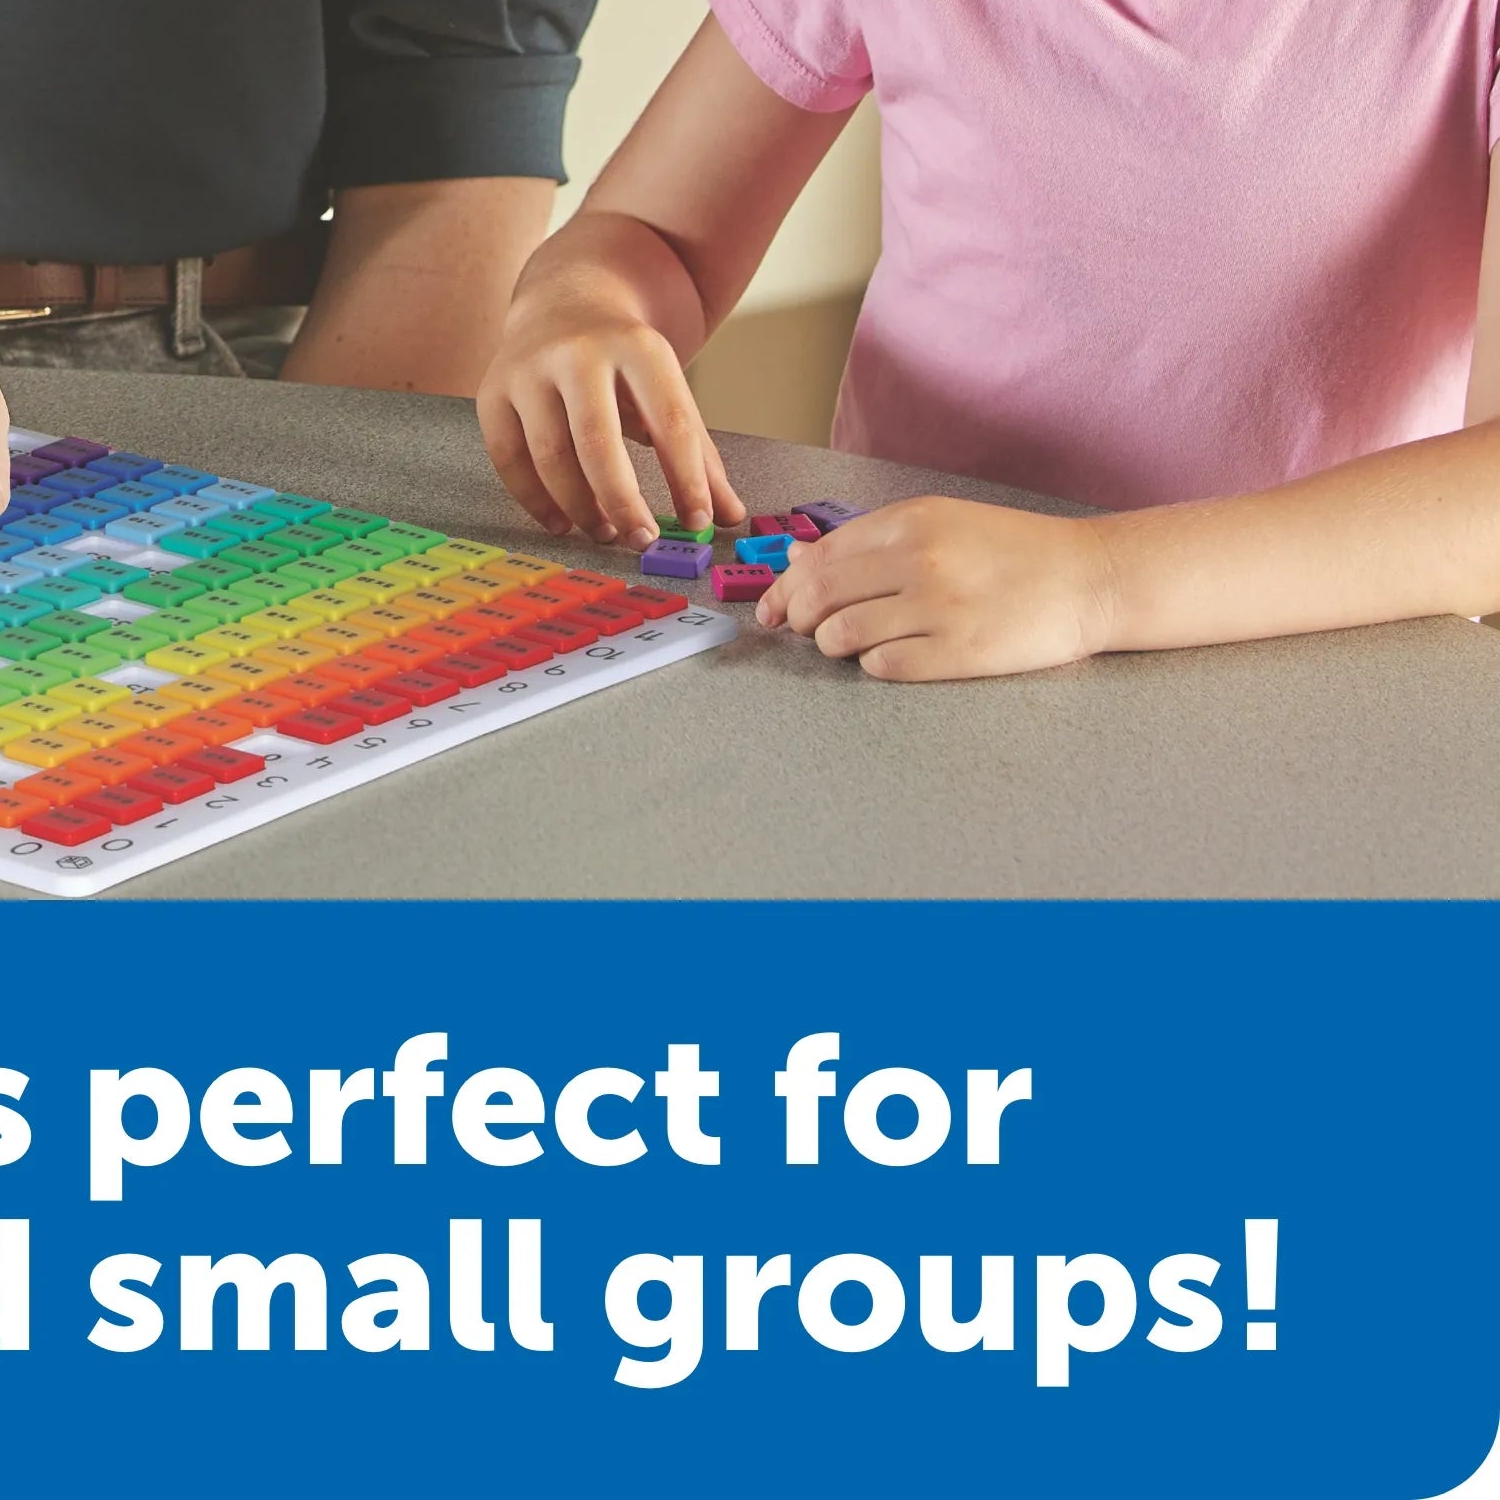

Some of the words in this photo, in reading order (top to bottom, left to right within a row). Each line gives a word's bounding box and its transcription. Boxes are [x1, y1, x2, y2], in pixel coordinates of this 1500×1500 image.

[677, 613, 714, 625] 12
[634, 630, 663, 641] 11
[586, 647, 624, 660] 10
[544, 665, 565, 675] 9
[498, 682, 528, 693] 8
[448, 703, 479, 712] 7
[407, 719, 433, 729] 6
[354, 737, 386, 749] 5
[306, 756, 332, 769] 4
[257, 776, 288, 787] 3
[206, 795, 238, 808] 2
[155, 819, 178, 828] 1
[10, 842, 42, 855] 0
[101, 839, 133, 851] 0
